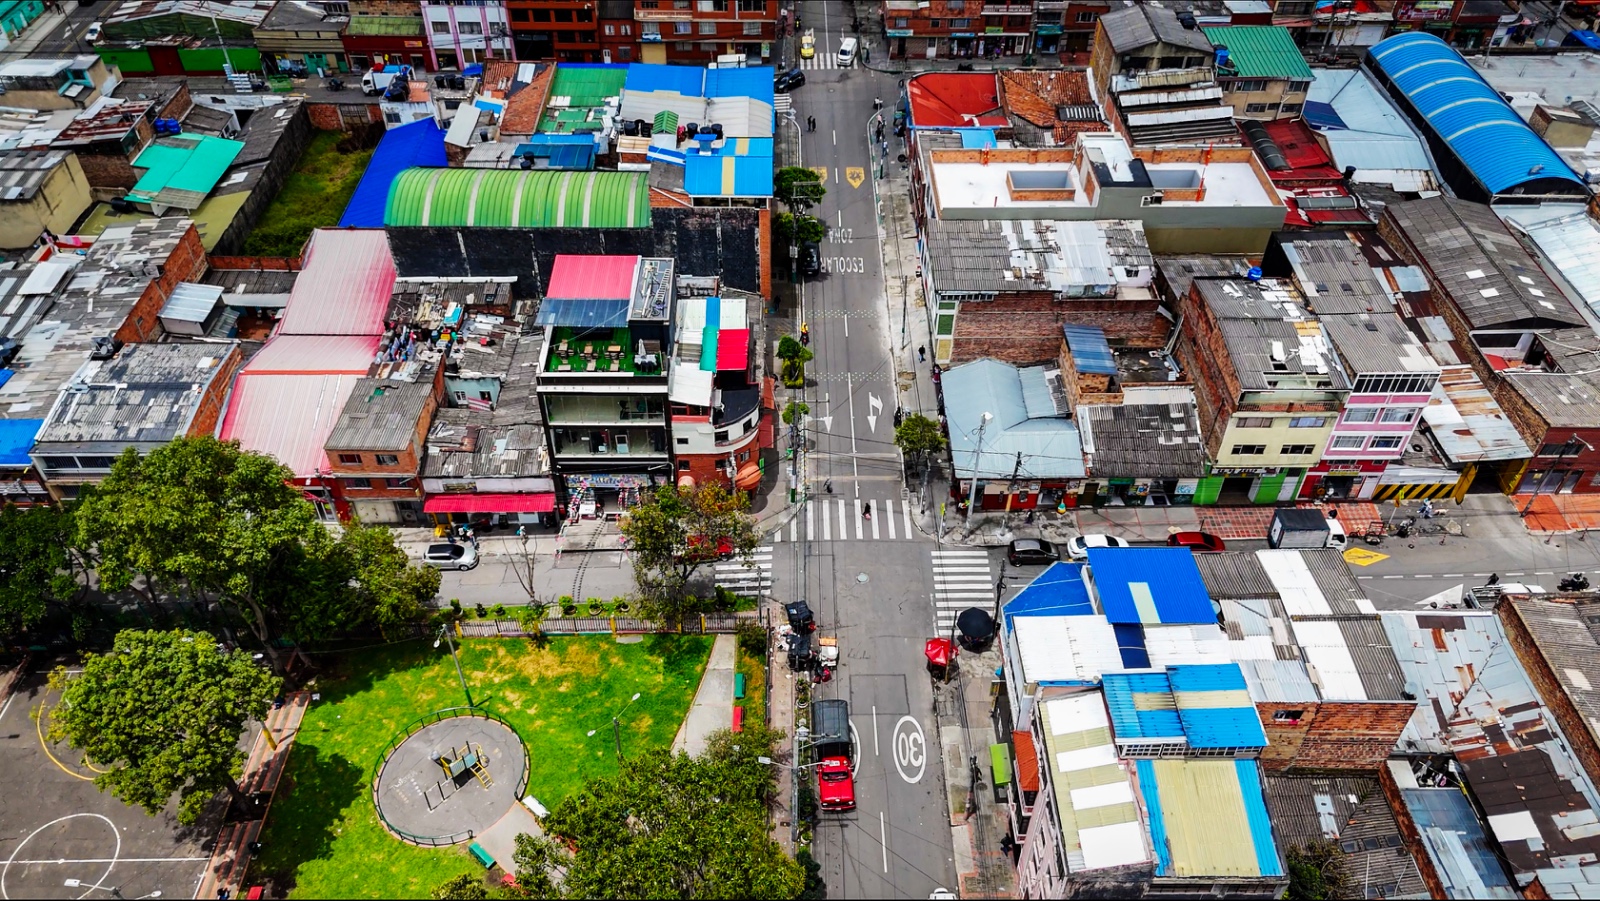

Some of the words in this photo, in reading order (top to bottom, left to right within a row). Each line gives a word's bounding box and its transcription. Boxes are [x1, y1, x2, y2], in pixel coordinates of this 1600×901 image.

[828, 228, 853, 244] ZONA
[820, 257, 864, 273] ESCOLAR
[898, 732, 923, 767] 30
